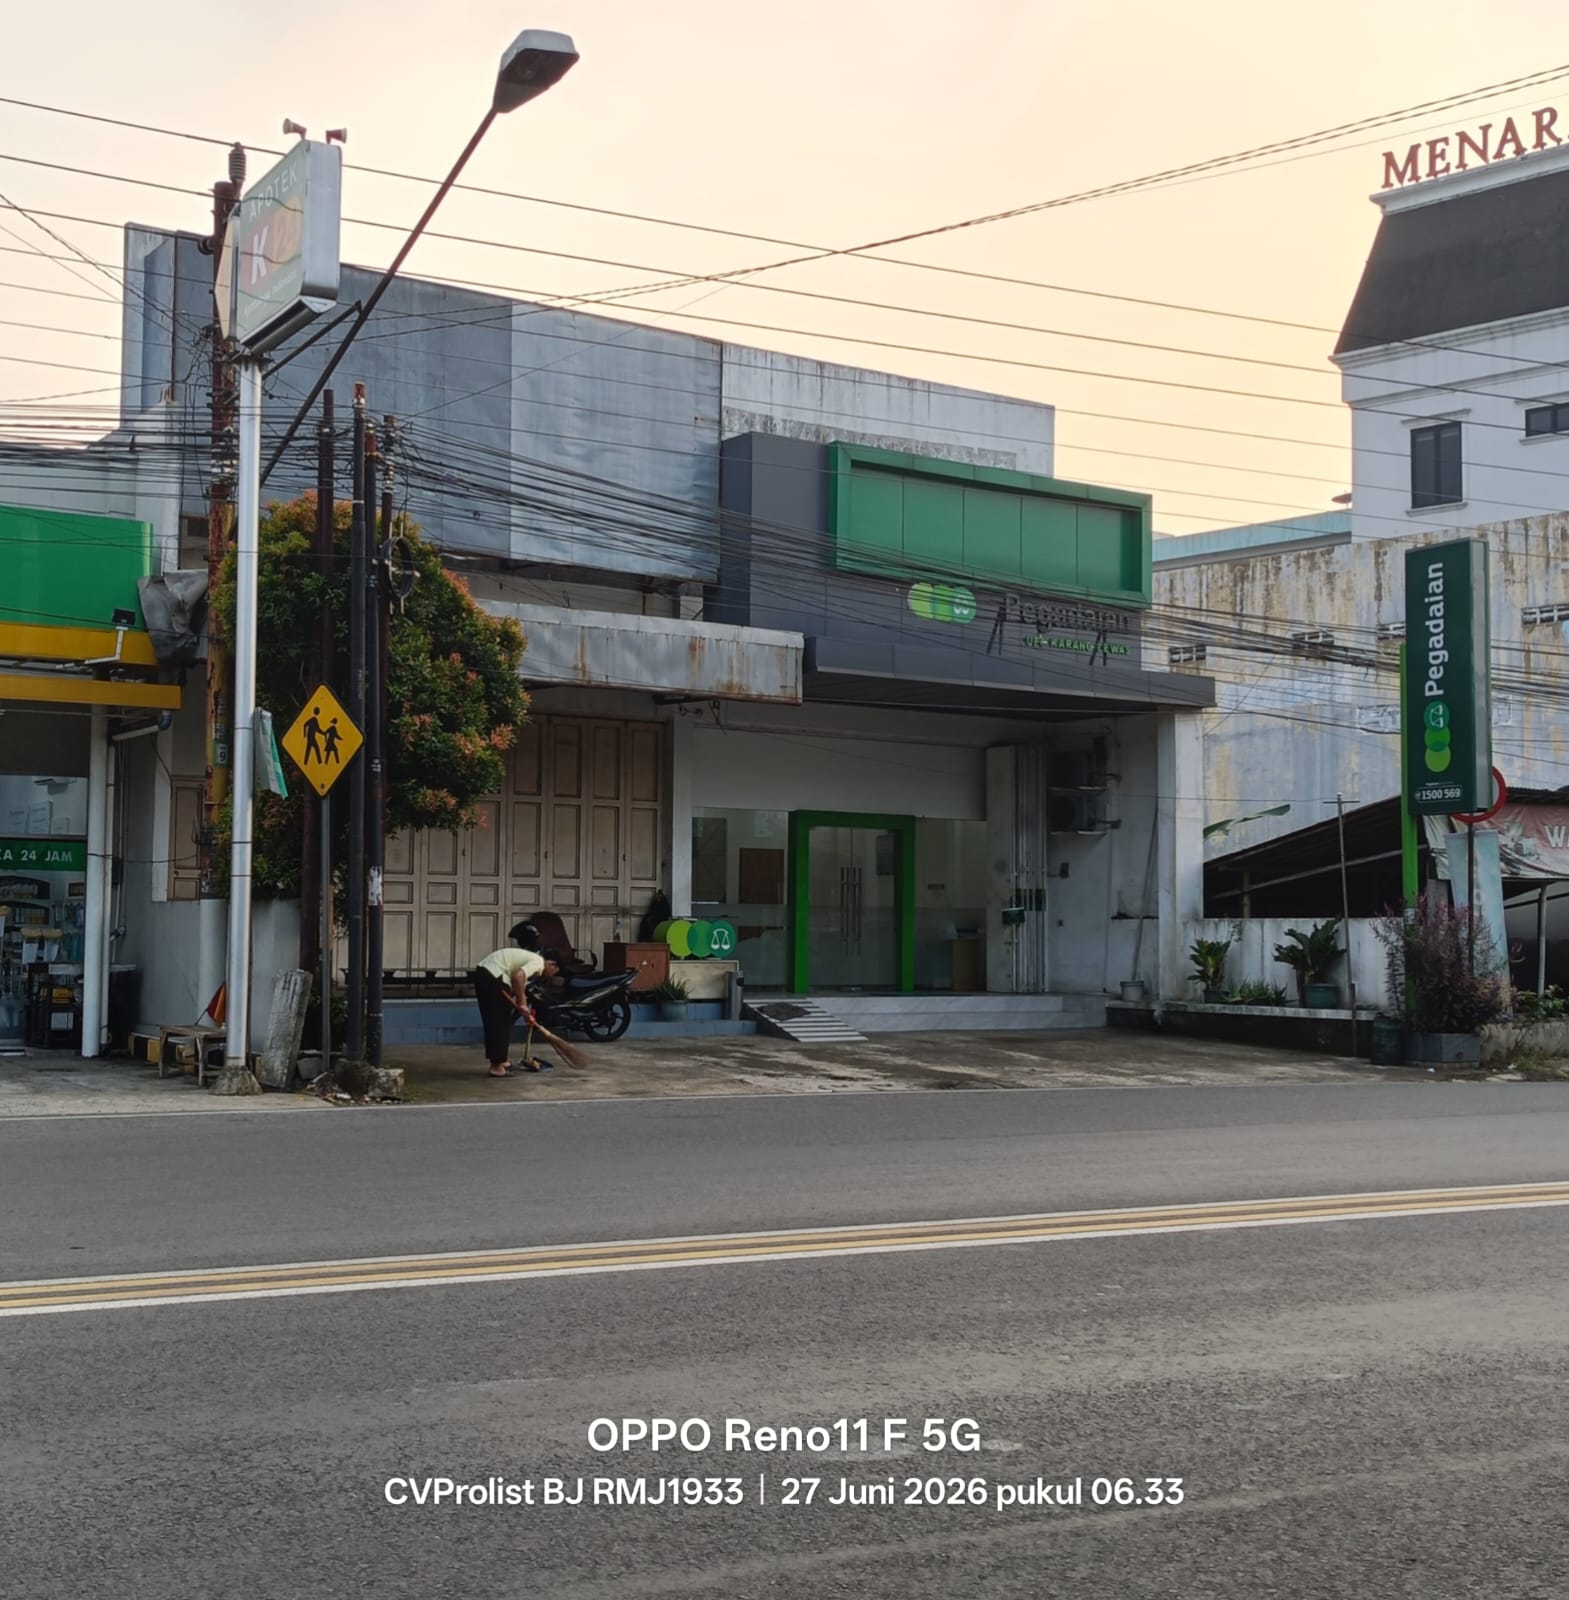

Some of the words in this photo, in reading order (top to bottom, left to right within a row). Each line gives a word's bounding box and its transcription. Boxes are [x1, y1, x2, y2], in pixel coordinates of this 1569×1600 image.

[1381, 106, 1569, 189] MENAR
[248, 164, 297, 222] APOTEK
[250, 224, 269, 286] K
[1425, 561, 1448, 697] Pegadaian
[1422, 789, 1443, 800] 1500
[1443, 787, 1461, 799] 569
[0, 849, 13, 861] A
[20, 849, 37, 861] 24
[44, 850, 73, 862] JAM
[1543, 825, 1569, 849] W
